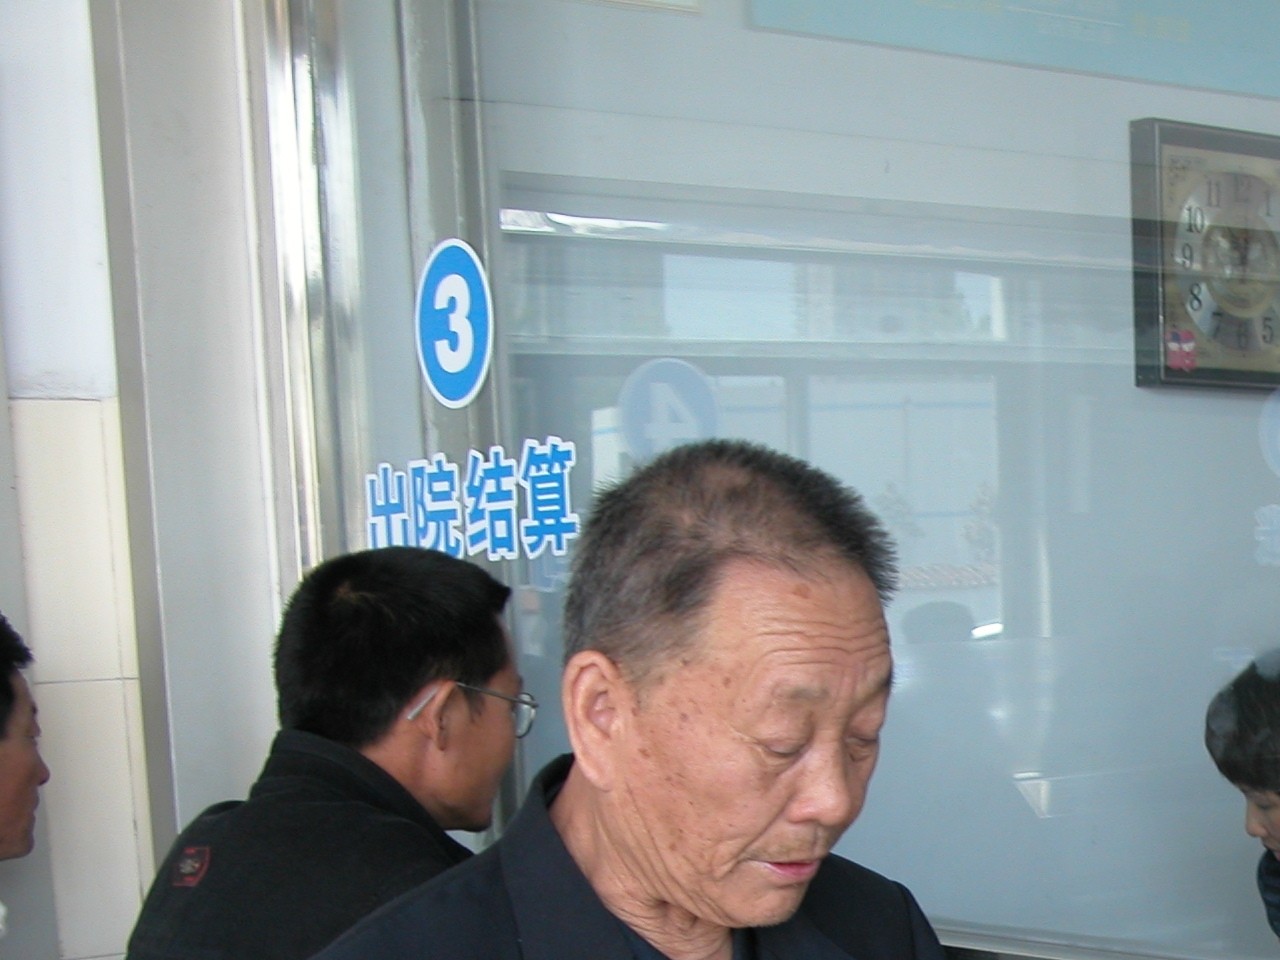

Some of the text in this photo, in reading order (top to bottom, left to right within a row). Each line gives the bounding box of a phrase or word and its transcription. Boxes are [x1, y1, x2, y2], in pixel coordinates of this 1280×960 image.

[1186, 206, 1205, 234] 10
[1181, 243, 1194, 270] 9
[1188, 282, 1203, 311] 8
[434, 274, 474, 373] 3
[1262, 316, 1275, 345] 5
[366, 436, 580, 560] 出院结算
